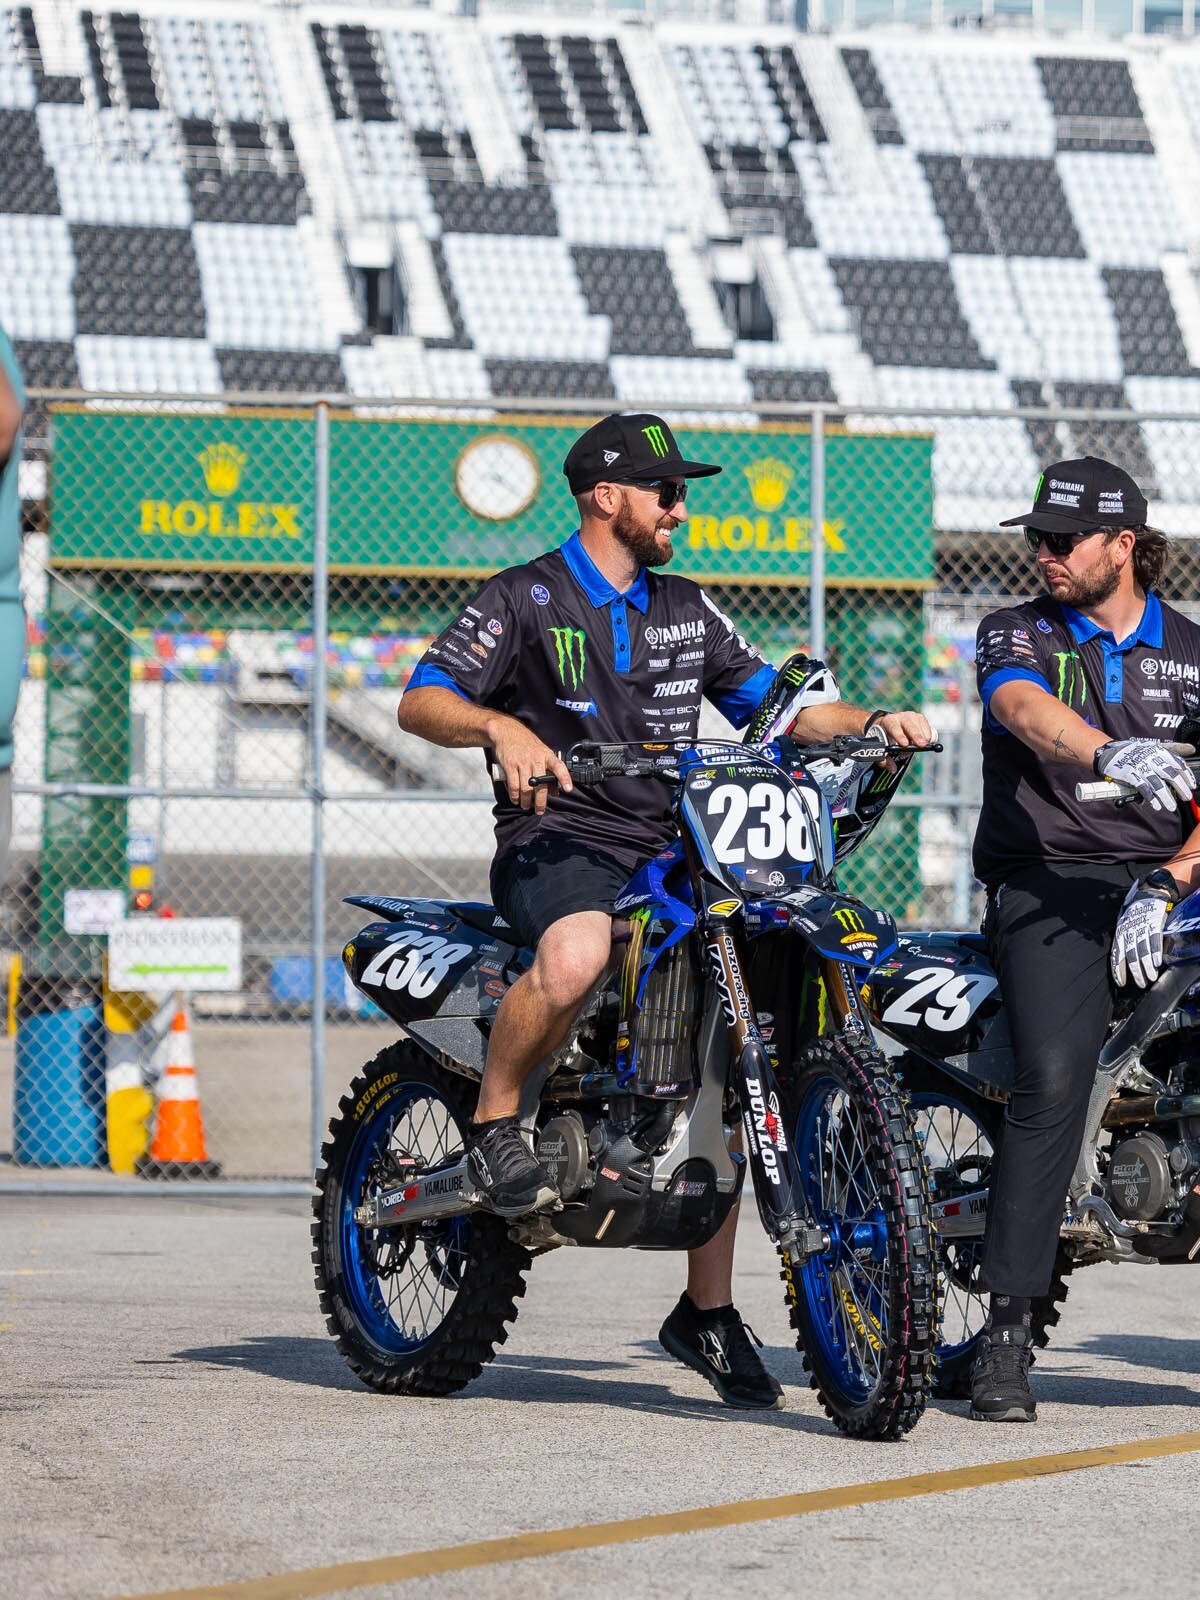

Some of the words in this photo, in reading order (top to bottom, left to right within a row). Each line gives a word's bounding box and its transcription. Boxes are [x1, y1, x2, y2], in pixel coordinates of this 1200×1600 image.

[1057, 483, 1084, 493] YAMAHA
[1050, 491, 1080, 504] YAMALUBE
[140, 500, 299, 538] ROLEX
[688, 515, 848, 551] ROLEX
[657, 620, 705, 644] YAMAHA
[651, 637, 704, 650] RACING
[681, 650, 705, 661] YAMAH
[652, 678, 699, 697] THOR
[756, 703, 781, 743] MONST
[850, 748, 885, 757] ARC
[738, 766, 780, 775] MONSTER
[707, 782, 821, 863] 238
[361, 896, 409, 912] DUNLOP
[847, 942, 878, 951] YAMAHA
[360, 930, 473, 999] 238
[882, 967, 999, 1031] 29
[356, 1072, 398, 1116] DUNLOP
[744, 1111, 758, 1155] BRAKING
[746, 1077, 780, 1185] DUNLOP
[1113, 1164, 1136, 1175] star
[424, 1175, 464, 1197] YAMALUBE
[1111, 1176, 1150, 1185] REKLUSE
[381, 1190, 406, 1208] VORTEX
[969, 1199, 989, 1215] YAM
